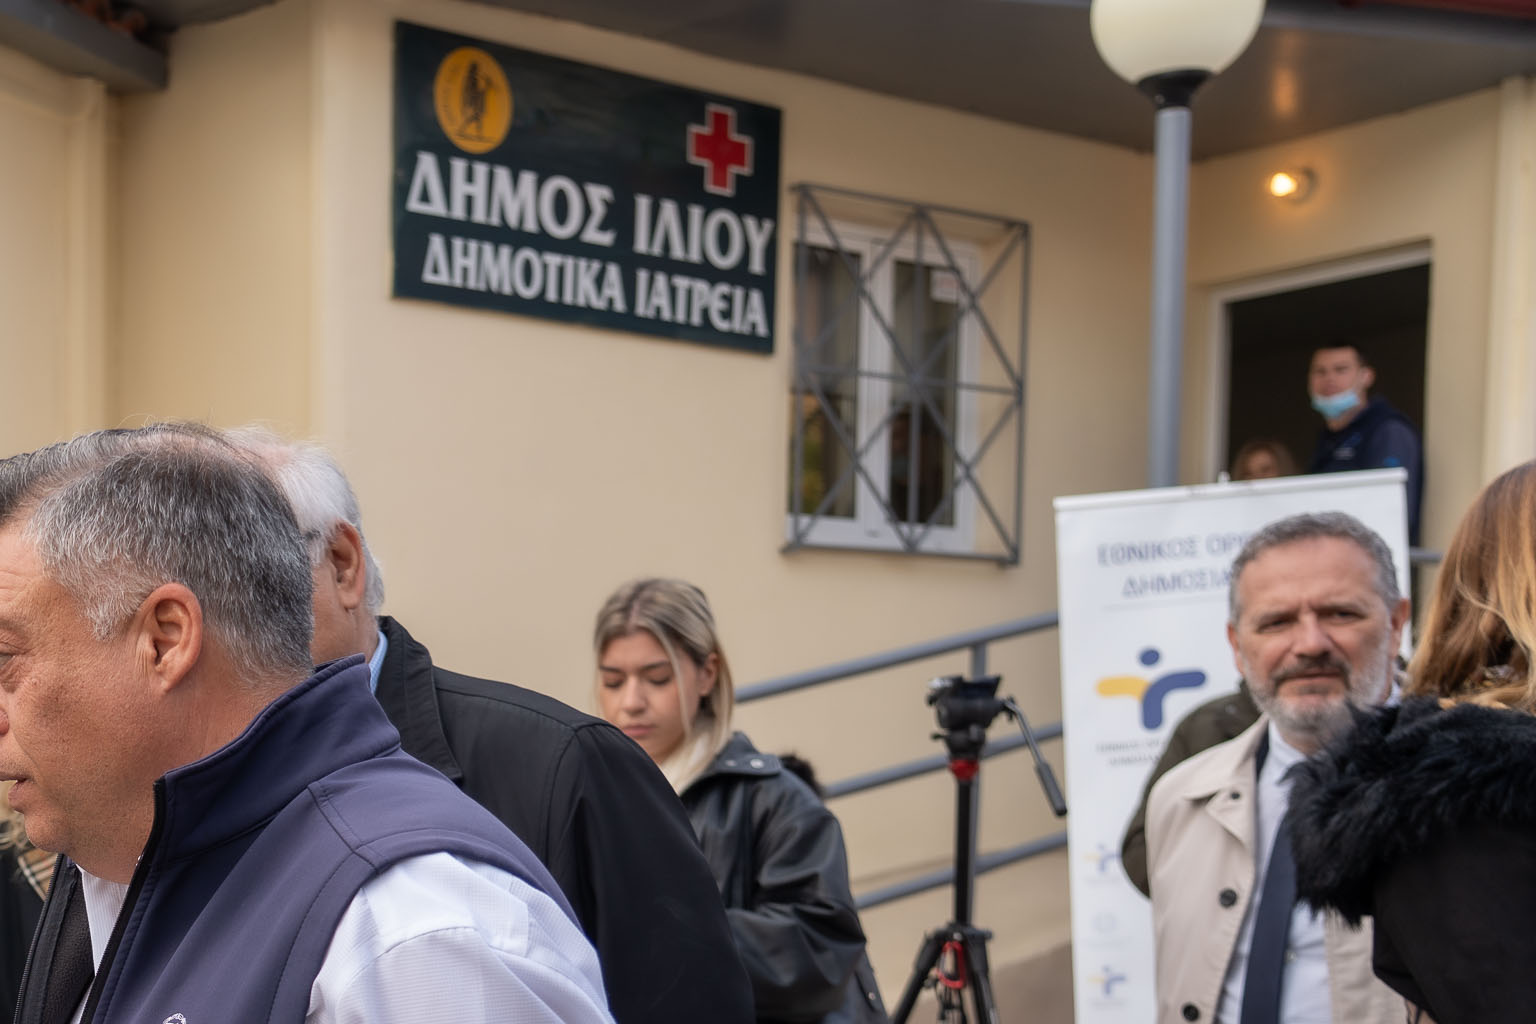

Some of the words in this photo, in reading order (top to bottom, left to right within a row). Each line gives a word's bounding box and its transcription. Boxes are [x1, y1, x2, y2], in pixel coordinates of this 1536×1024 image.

[405, 150, 616, 247] ΔΗΜΟΣ
[633, 193, 775, 275] ΙΛΙΟΥ
[421, 232, 627, 313] ΔΗΜΟΤΙΚΑ
[634, 268, 769, 337] ΙΑΤΡΕΙΑ
